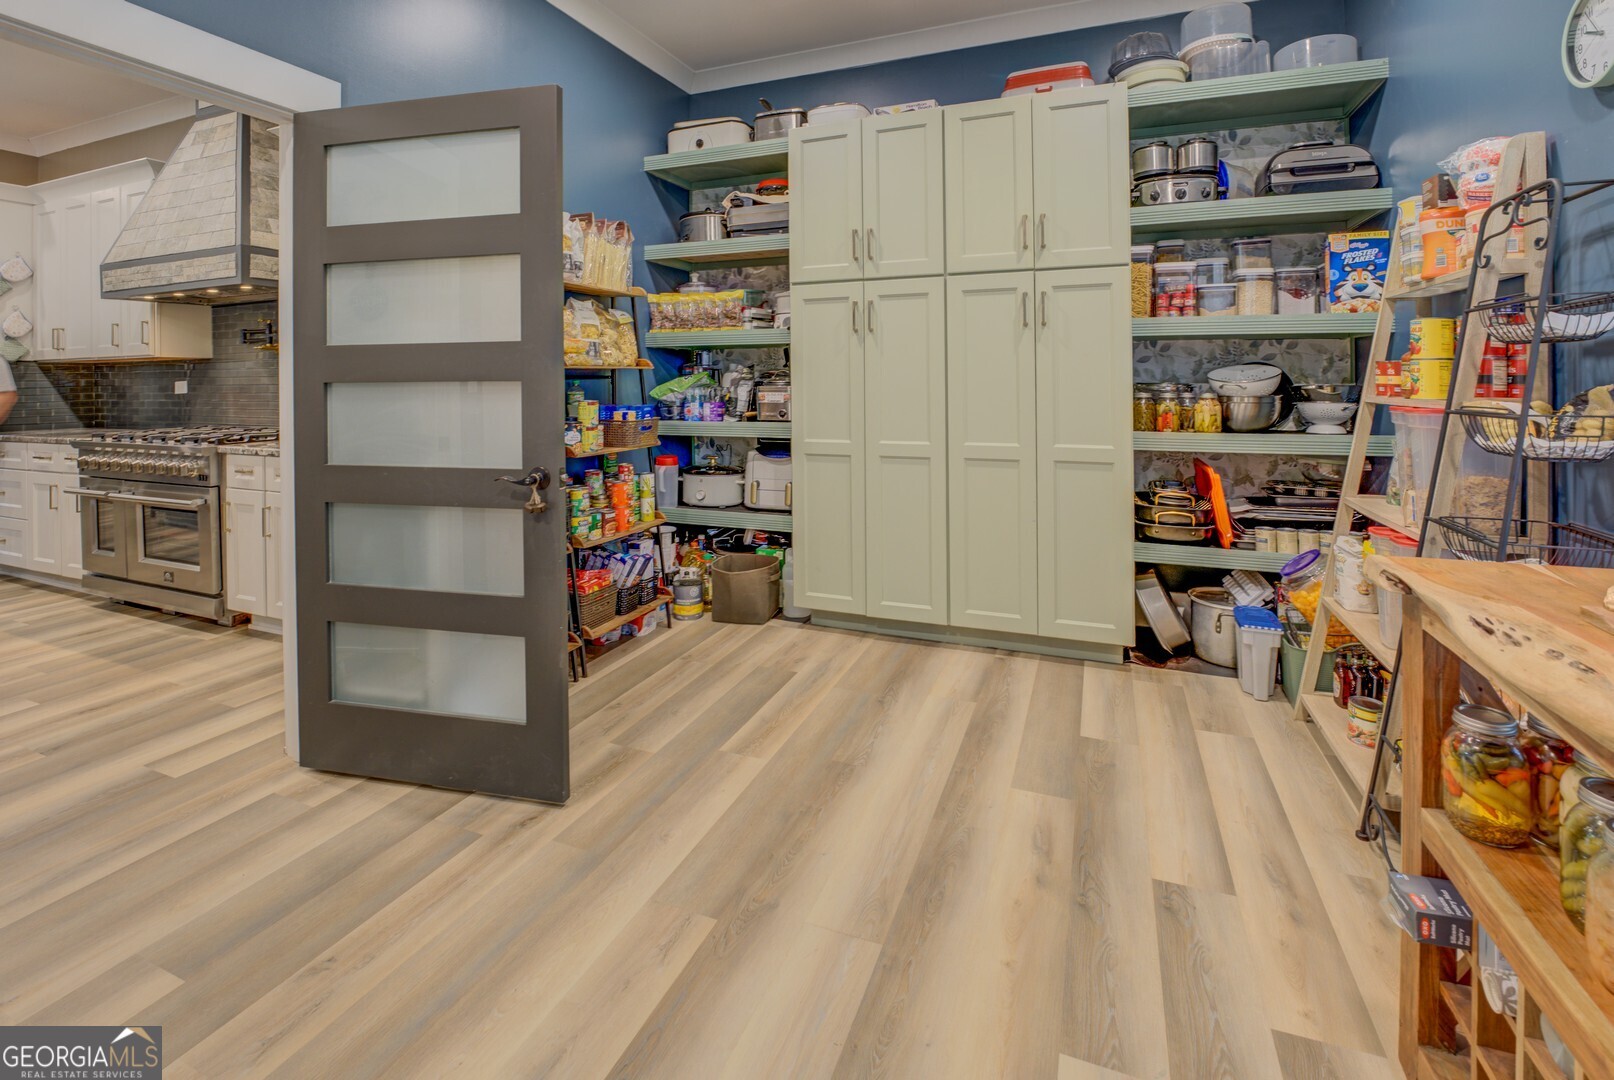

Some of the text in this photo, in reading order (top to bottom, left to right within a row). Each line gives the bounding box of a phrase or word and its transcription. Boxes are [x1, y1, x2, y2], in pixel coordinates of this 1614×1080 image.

[1578, 44, 1583, 55] 9
[1582, 58, 1588, 69] 8
[1591, 63, 1597, 75] 7
[1436, 219, 1466, 229] DUN
[1341, 248, 1379, 260] FROSTED
[1343, 254, 1376, 265] FLAKES
[1457, 928, 1465, 945] Pastry
